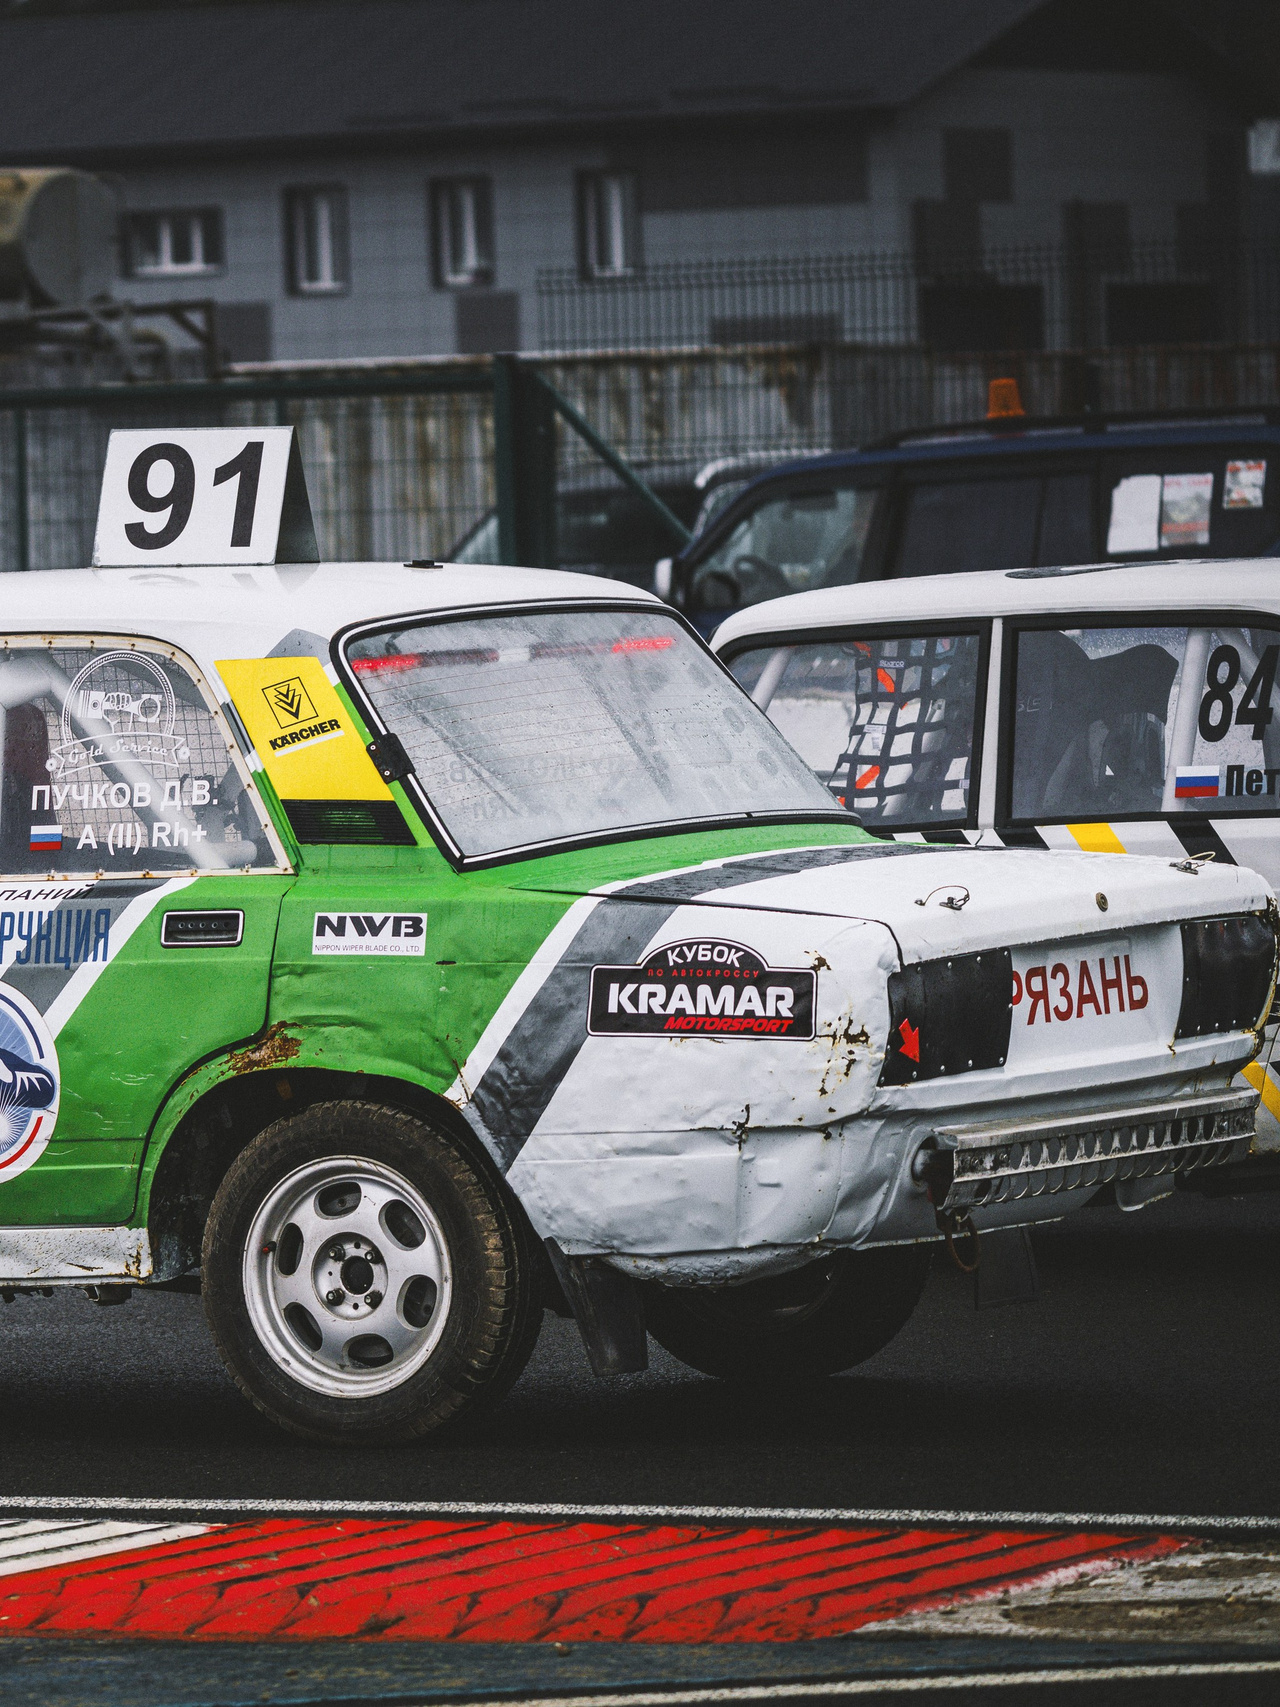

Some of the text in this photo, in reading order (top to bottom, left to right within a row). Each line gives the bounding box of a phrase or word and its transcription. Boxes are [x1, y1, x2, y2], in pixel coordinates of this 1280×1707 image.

[124, 441, 265, 550] 91
[1198, 644, 1280, 743] 84
[269, 718, 341, 750] KÄRCHER
[68, 738, 168, 763] Gold Service
[31, 782, 152, 811] ПУЧКОВ
[152, 821, 208, 848] Rh+
[316, 915, 424, 938] NWB
[667, 944, 745, 968] КУБОК
[647, 968, 760, 978] ПО АВТОКРОССУ
[608, 982, 794, 1018] KRAMAR
[664, 1016, 794, 1033] MOTORSPORT
